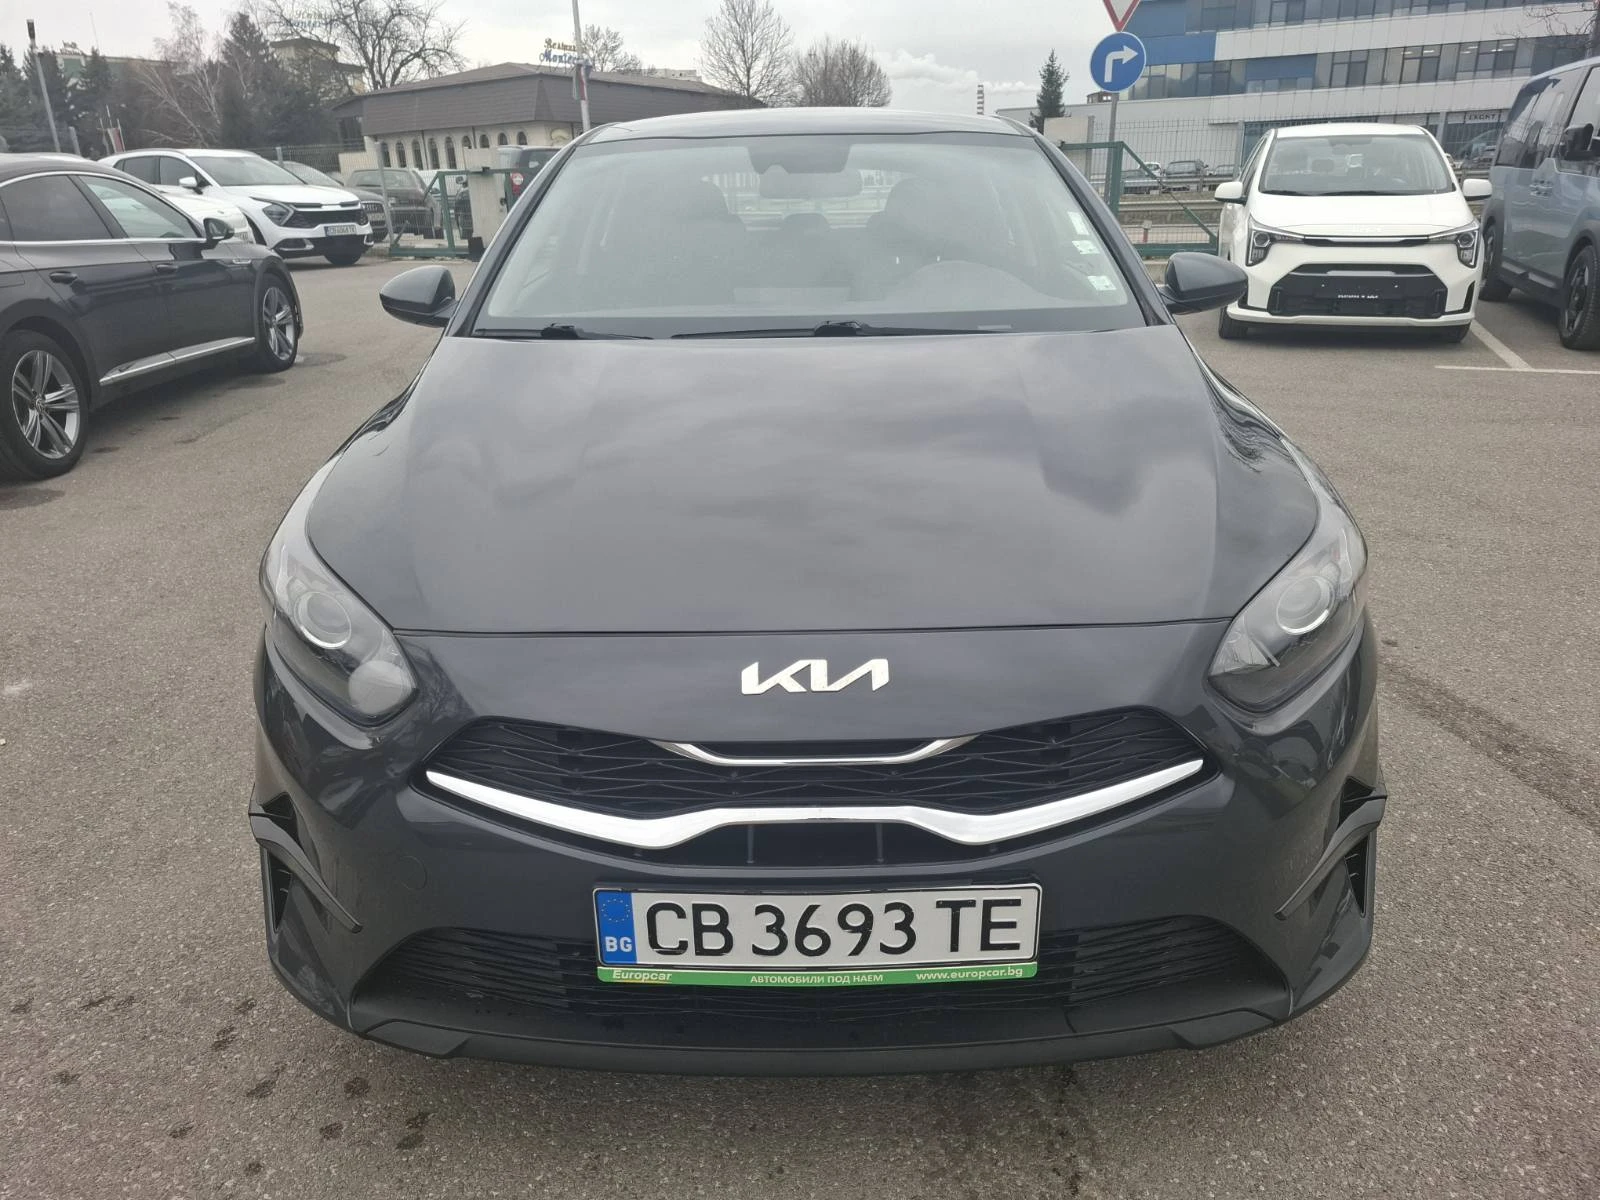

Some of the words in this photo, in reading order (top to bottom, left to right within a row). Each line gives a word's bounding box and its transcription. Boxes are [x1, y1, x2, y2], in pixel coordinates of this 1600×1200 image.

[741, 659, 889, 694] KIA
[752, 901, 917, 957] 3693
[935, 898, 1022, 952] TE
[604, 936, 632, 954] BG
[612, 969, 672, 982] Europcar
[750, 975, 825, 984] АВТОМОБИЛИ
[827, 975, 851, 984] ПОД
[853, 974, 884, 983] НАЕМ
[916, 968, 1024, 981] www.europcar.bg
